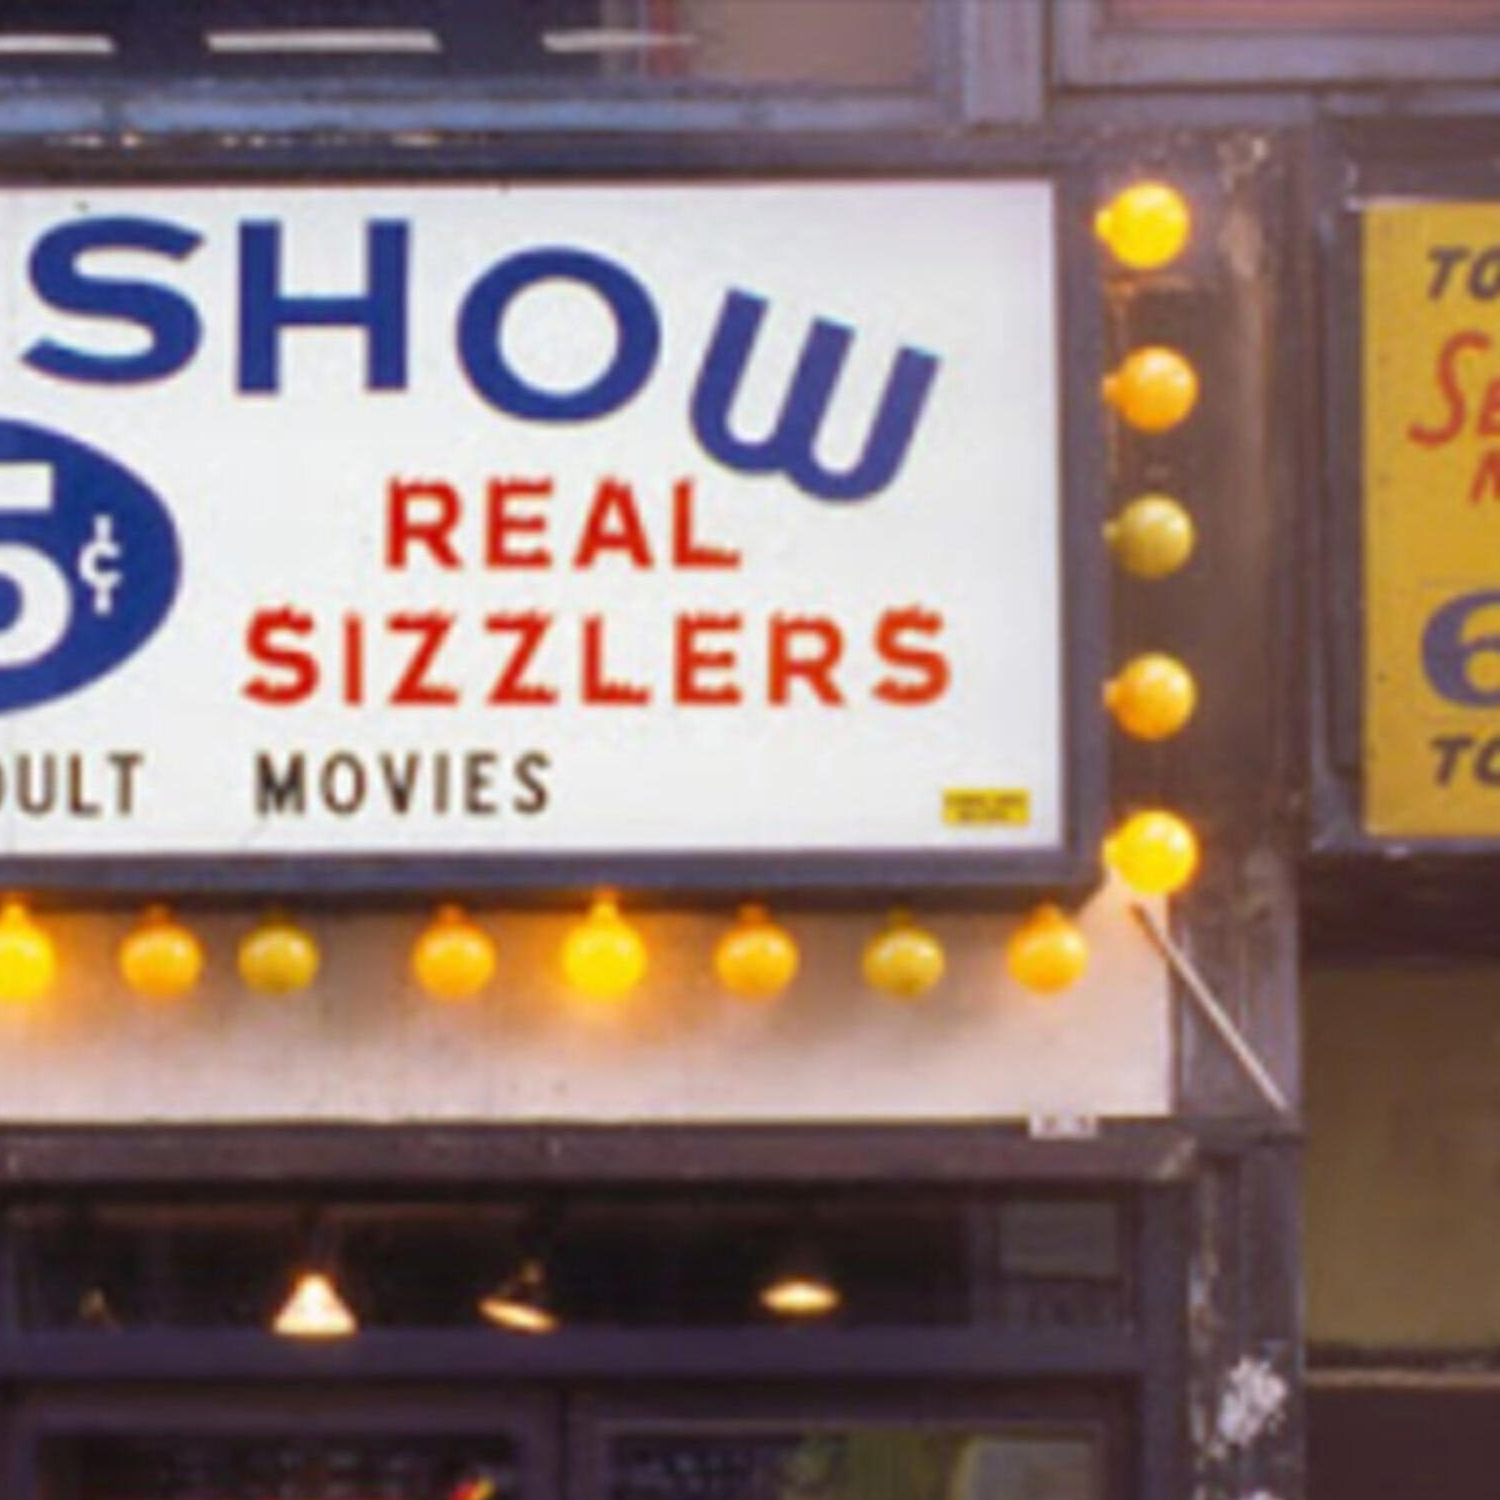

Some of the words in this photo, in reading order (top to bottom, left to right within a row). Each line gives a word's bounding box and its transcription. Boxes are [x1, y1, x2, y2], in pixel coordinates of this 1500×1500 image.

[21, 216, 940, 503] SHOW
[385, 478, 740, 570] REAL
[255, 751, 551, 816] MOVIES
